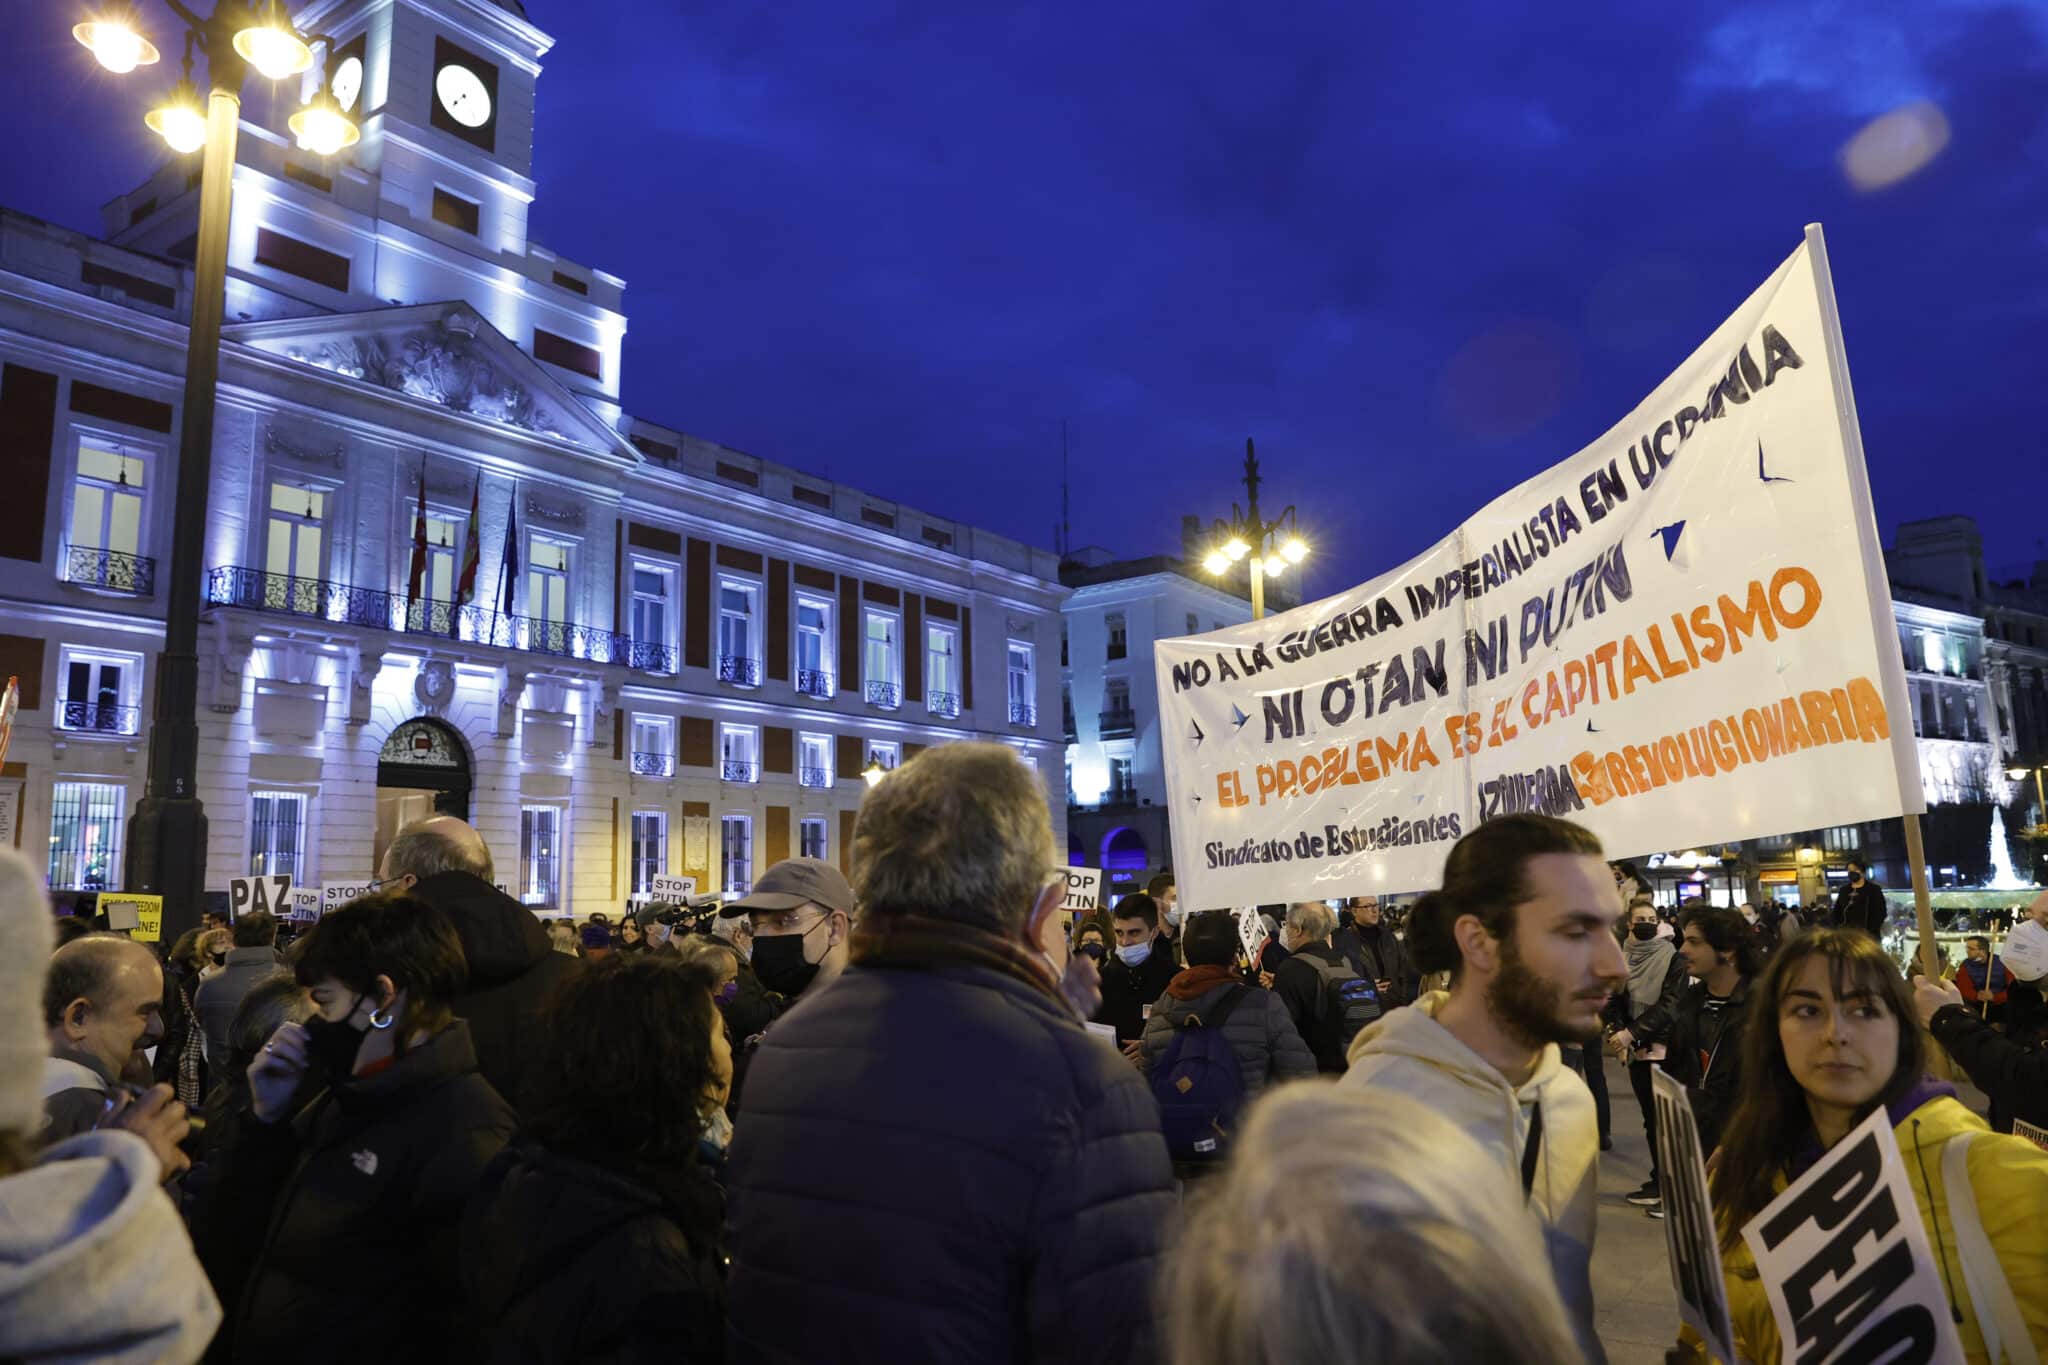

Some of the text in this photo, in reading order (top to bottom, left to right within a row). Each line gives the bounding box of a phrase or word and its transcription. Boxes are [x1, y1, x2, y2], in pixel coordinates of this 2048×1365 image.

[1173, 659, 1211, 693] NO
[1216, 653, 1239, 683] A
[1236, 642, 1274, 677] LA
[1276, 597, 1404, 664] GUERRA
[1405, 496, 1582, 621] IMPERIALISTA
[1579, 458, 1628, 525] EN
[1216, 567, 1822, 808] EL PROBLEMA ES EL CAPITALISMO
[1262, 690, 1306, 743] NI
[1320, 638, 1449, 727] OTAN
[1465, 614, 1508, 687] NI
[1604, 676, 1891, 798] REVOLUCIONARIA
[1205, 812, 1462, 869] Sindicato de Estudiantes
[230, 875, 292, 916] PAZ
[294, 894, 317, 906] TOP
[656, 879, 692, 892] STOP
[1066, 874, 1095, 889] OP
[1066, 893, 1095, 909] TIN
[291, 909, 317, 920] UTIN
